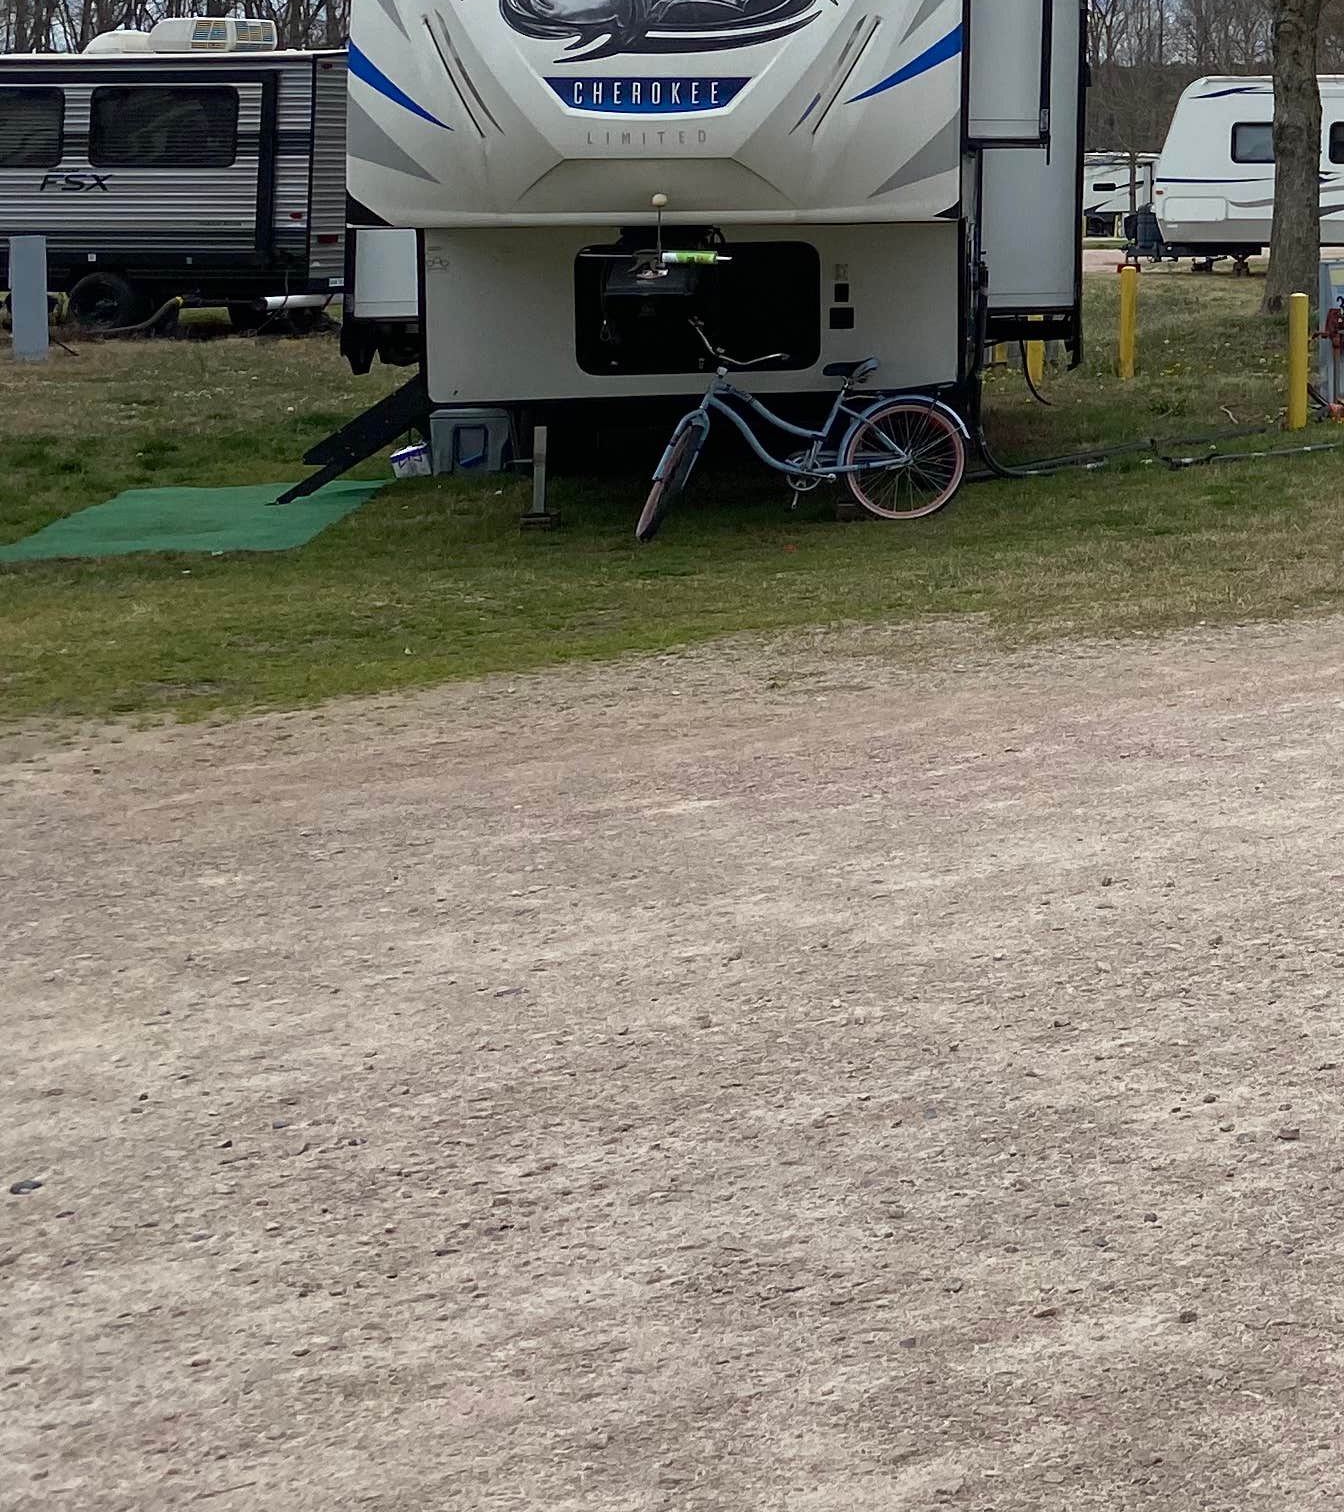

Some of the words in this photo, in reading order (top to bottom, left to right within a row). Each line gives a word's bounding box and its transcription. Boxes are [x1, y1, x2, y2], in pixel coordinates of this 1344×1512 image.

[573, 81, 719, 105] CHEROKEE
[587, 129, 707, 145] LIMITED
[40, 174, 113, 192] FSX
